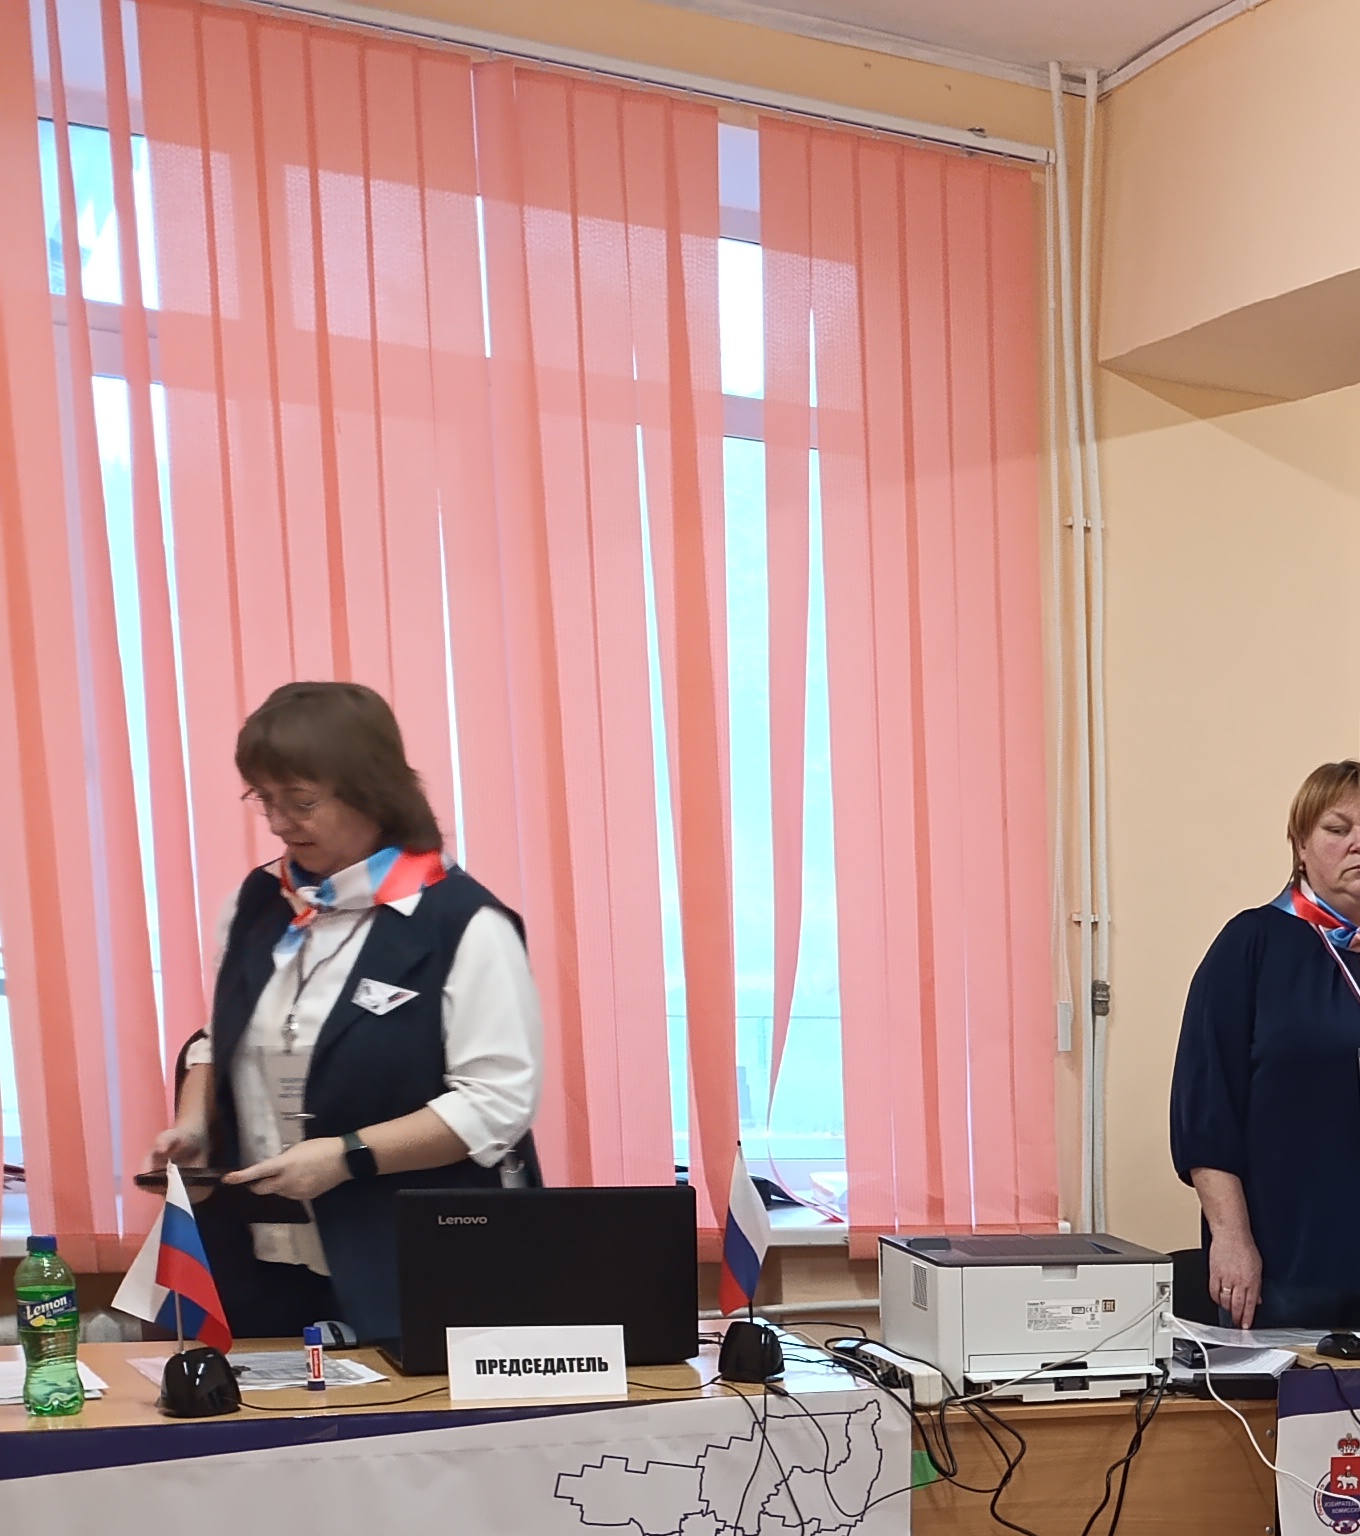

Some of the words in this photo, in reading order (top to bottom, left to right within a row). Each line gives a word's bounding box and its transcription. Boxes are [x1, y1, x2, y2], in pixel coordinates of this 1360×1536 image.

[437, 1214, 488, 1226] Lenovo
[26, 1296, 67, 1320] Lemon
[475, 1354, 610, 1377] ПРЕДСЕДАТЕЛЬ
